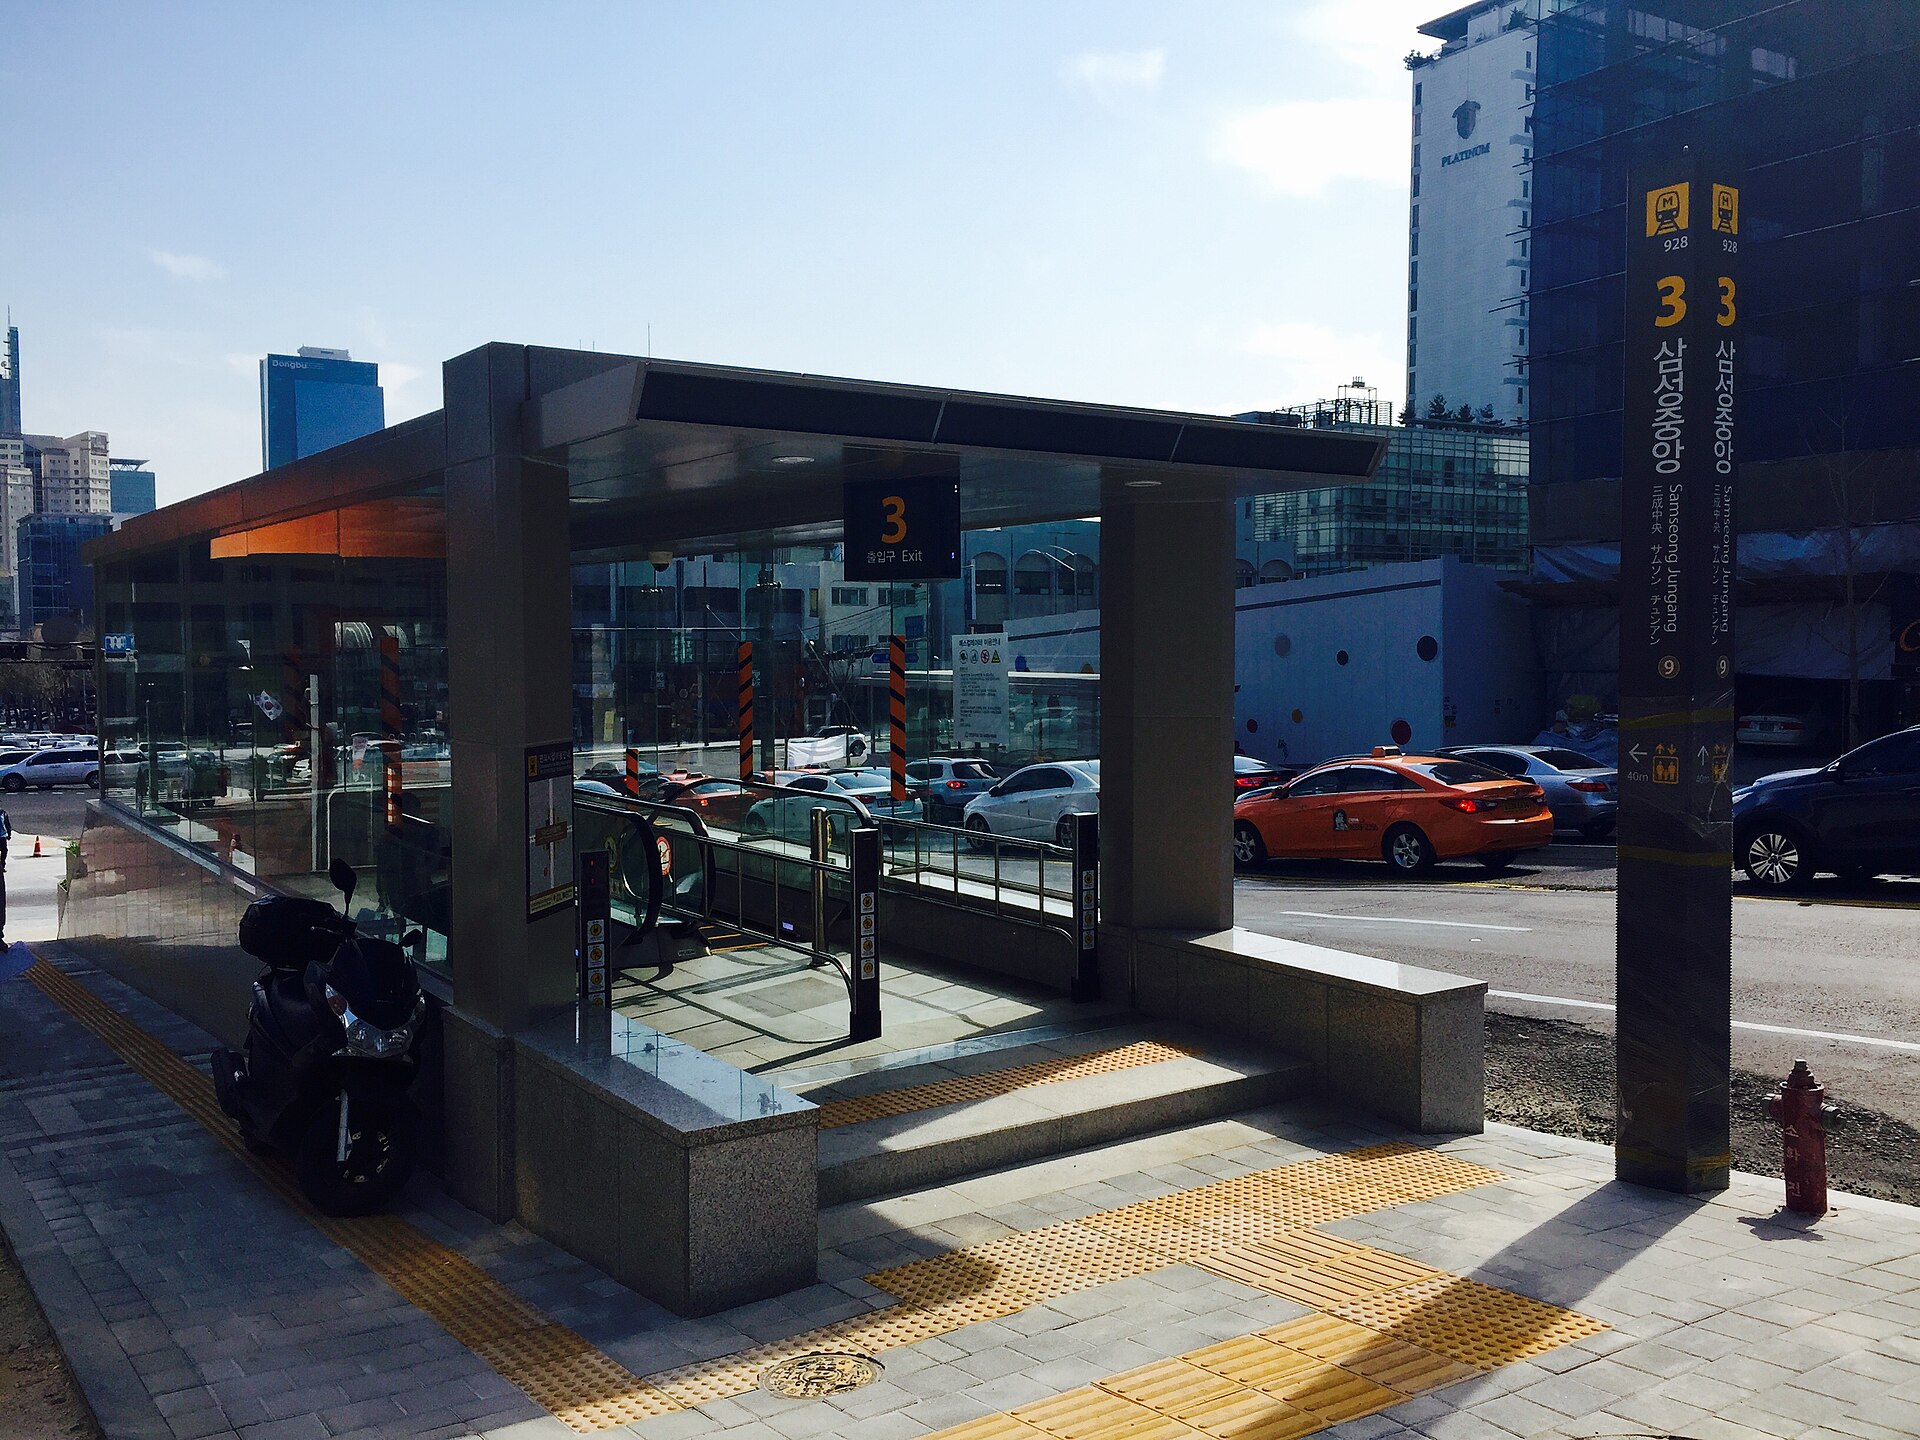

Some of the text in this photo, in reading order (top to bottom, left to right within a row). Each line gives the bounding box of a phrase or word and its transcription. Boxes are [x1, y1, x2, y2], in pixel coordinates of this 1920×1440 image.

[1441, 142, 1491, 167] PLATINUM
[1663, 235, 1689, 252] 928
[1722, 239, 1738, 254] 928
[1654, 275, 1688, 328] 3
[1716, 276, 1736, 327] 3
[272, 359, 308, 370] Dongbu
[1651, 337, 1688, 474] 삼성중앙
[1713, 340, 1737, 474] 삼성중앙
[881, 495, 907, 544] 3
[1651, 485, 1664, 534] 三成中央
[866, 549, 923, 564] 출입구 Exit
[1663, 483, 1683, 633] Samseong Jungang
[1720, 485, 1733, 633] Samseong Jungang
[1664, 659, 1675, 675] 9
[1719, 659, 1727, 675] 9
[1627, 771, 1649, 783] 40m
